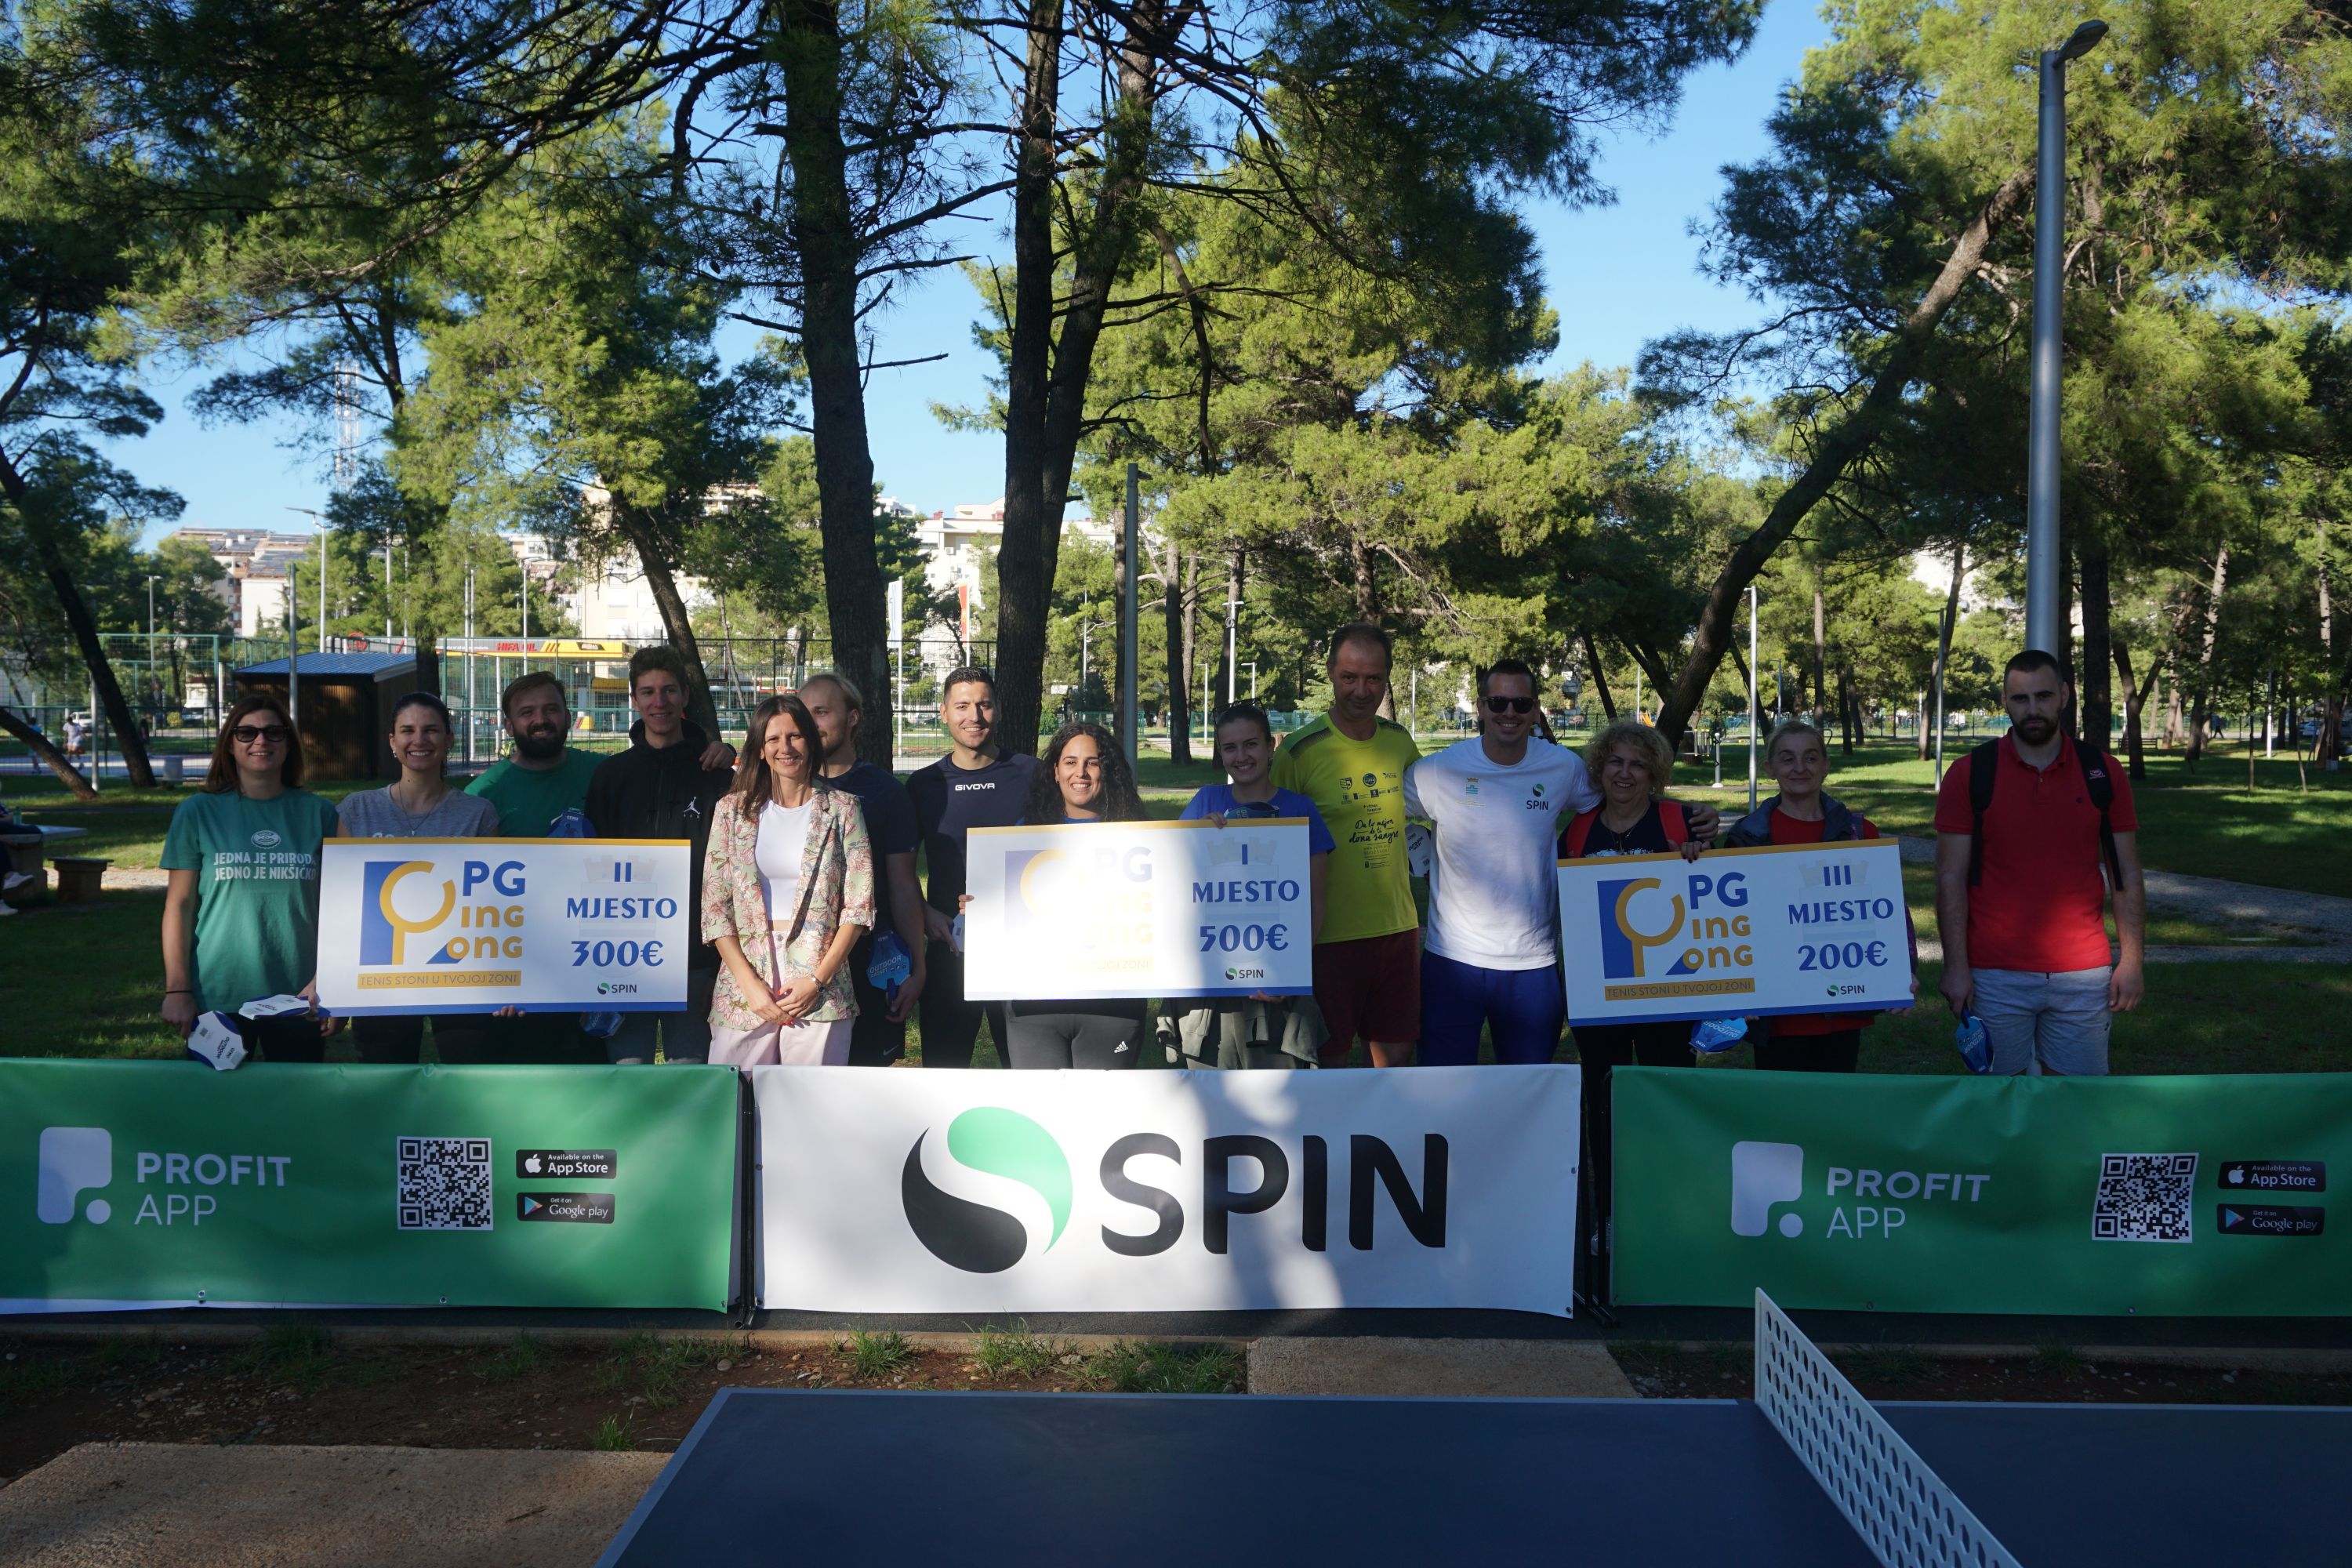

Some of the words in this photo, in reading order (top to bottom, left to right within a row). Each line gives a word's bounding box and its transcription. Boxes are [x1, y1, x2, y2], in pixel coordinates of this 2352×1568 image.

[955, 782, 995, 791] GIVOVA
[1526, 800, 1549, 811] SPIN
[214, 852, 251, 865] JEDNA
[253, 852, 267, 864] JE
[1094, 846, 1152, 883] PG
[1241, 844, 1248, 866] I
[215, 866, 251, 880] JEDNO
[253, 866, 266, 879] JE
[269, 863, 316, 880] NIKŠIĆKO
[463, 860, 526, 897] PG
[614, 862, 632, 883] II
[1823, 865, 1852, 887] III
[1192, 880, 1300, 903] MJESTO
[1688, 871, 1748, 910] PG
[567, 897, 677, 919] MJESTO
[1788, 898, 1894, 925] MJESTO
[1200, 924, 1289, 953] 500€
[571, 940, 664, 967] 300€
[869, 955, 902, 974] OUTDOOR
[1798, 941, 1889, 971] 200€
[361, 976, 392, 985] TENIS
[395, 975, 428, 985] STONI
[432, 975, 440, 985] U
[443, 975, 486, 984] TVOJOJ
[489, 974, 517, 983] ZONI
[1239, 969, 1264, 979] SPIN
[611, 984, 637, 993] SPIN
[1607, 988, 1636, 997] TENIS
[1639, 986, 1670, 996] STONI
[1683, 983, 1722, 993] TVOJOJ
[1725, 982, 1751, 991] ZONI
[1840, 985, 1865, 996] SPIN
[1964, 1032, 1984, 1054] OUTDOOR
[137, 1152, 292, 1187] PROFIT
[547, 1162, 574, 1176] App
[575, 1162, 608, 1174] Store
[1827, 1167, 1991, 1203] PROFIT
[2250, 1173, 2278, 1188] App
[2280, 1174, 2316, 1186] Store
[1099, 1131, 1450, 1257] SPIN
[134, 1193, 217, 1226] APP
[549, 1204, 586, 1219] Google
[588, 1206, 608, 1219] play
[1826, 1207, 1907, 1239] APP
[2252, 1217, 2293, 1232] Google
[2296, 1219, 2318, 1232] play
